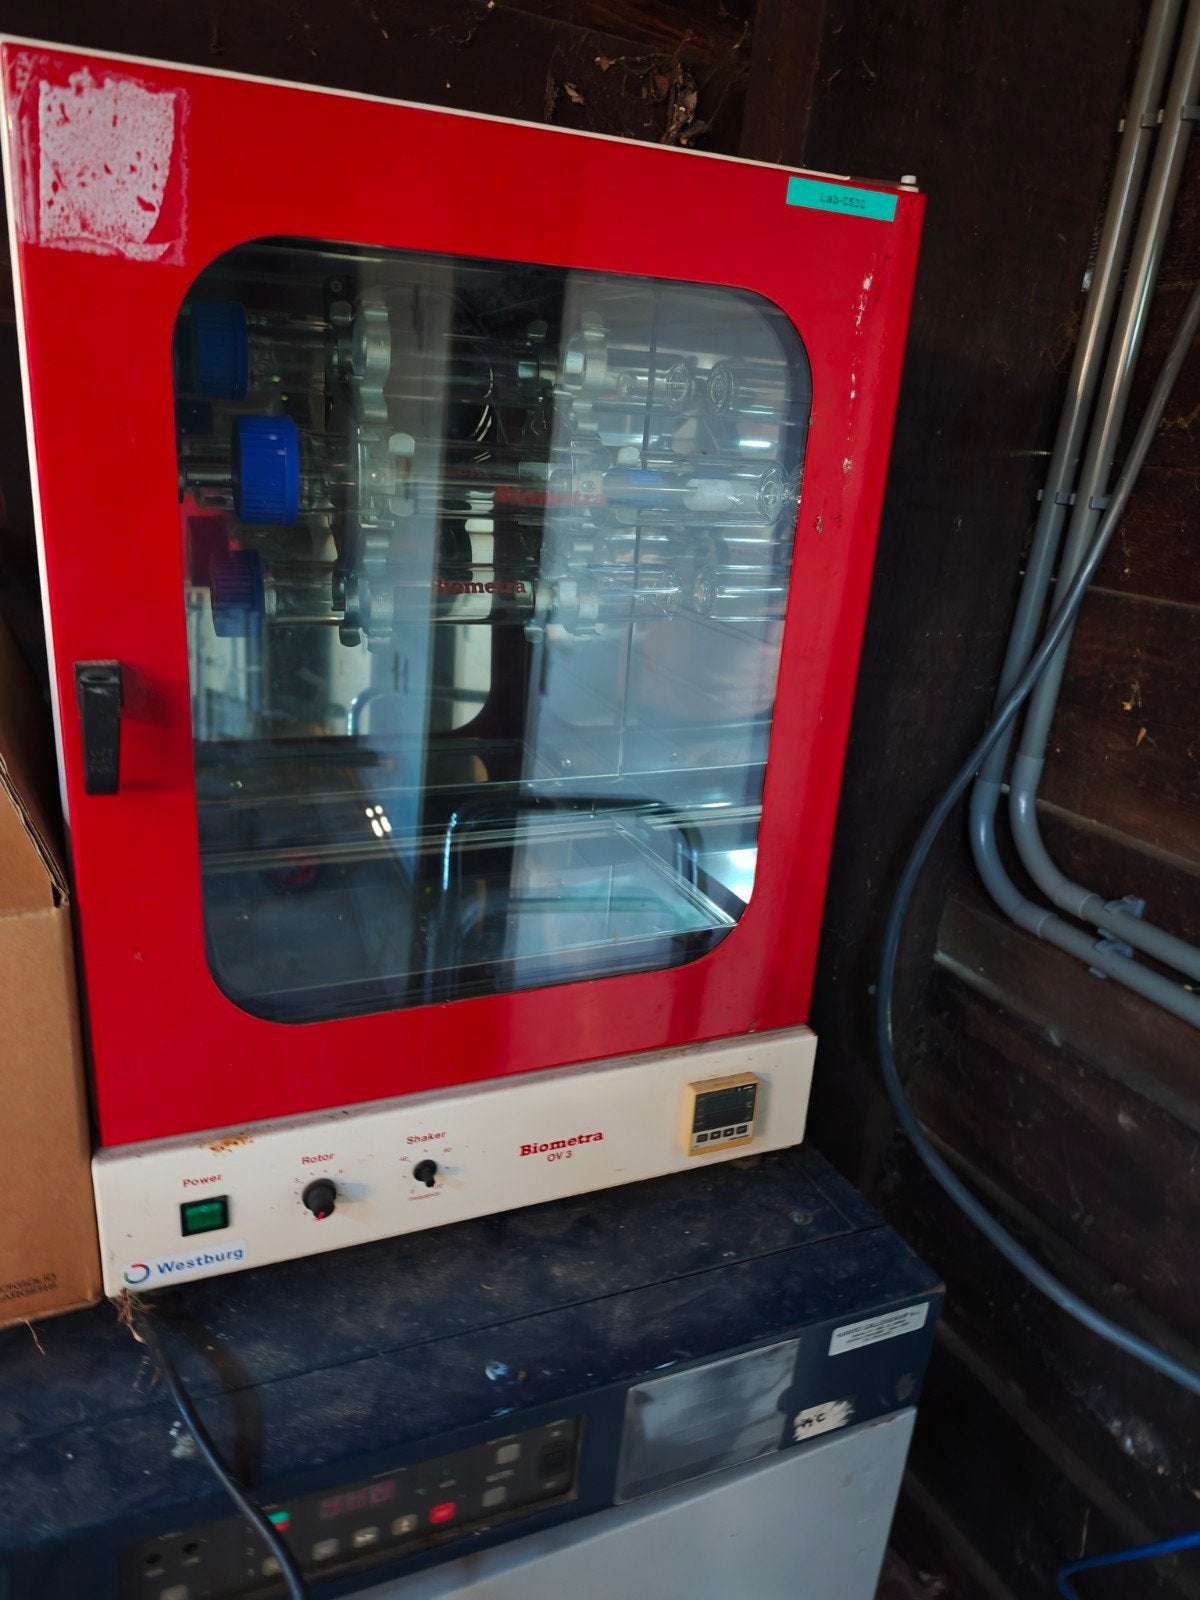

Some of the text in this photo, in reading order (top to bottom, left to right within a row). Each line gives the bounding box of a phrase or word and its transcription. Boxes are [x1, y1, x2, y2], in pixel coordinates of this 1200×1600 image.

[406, 1132, 446, 1145] Shaker
[519, 1132, 603, 1157] Biometra
[301, 1153, 335, 1165] Rotor
[547, 1150, 573, 1162] OV 3
[182, 1174, 222, 1187] Power
[156, 1249, 243, 1274] Westburg
